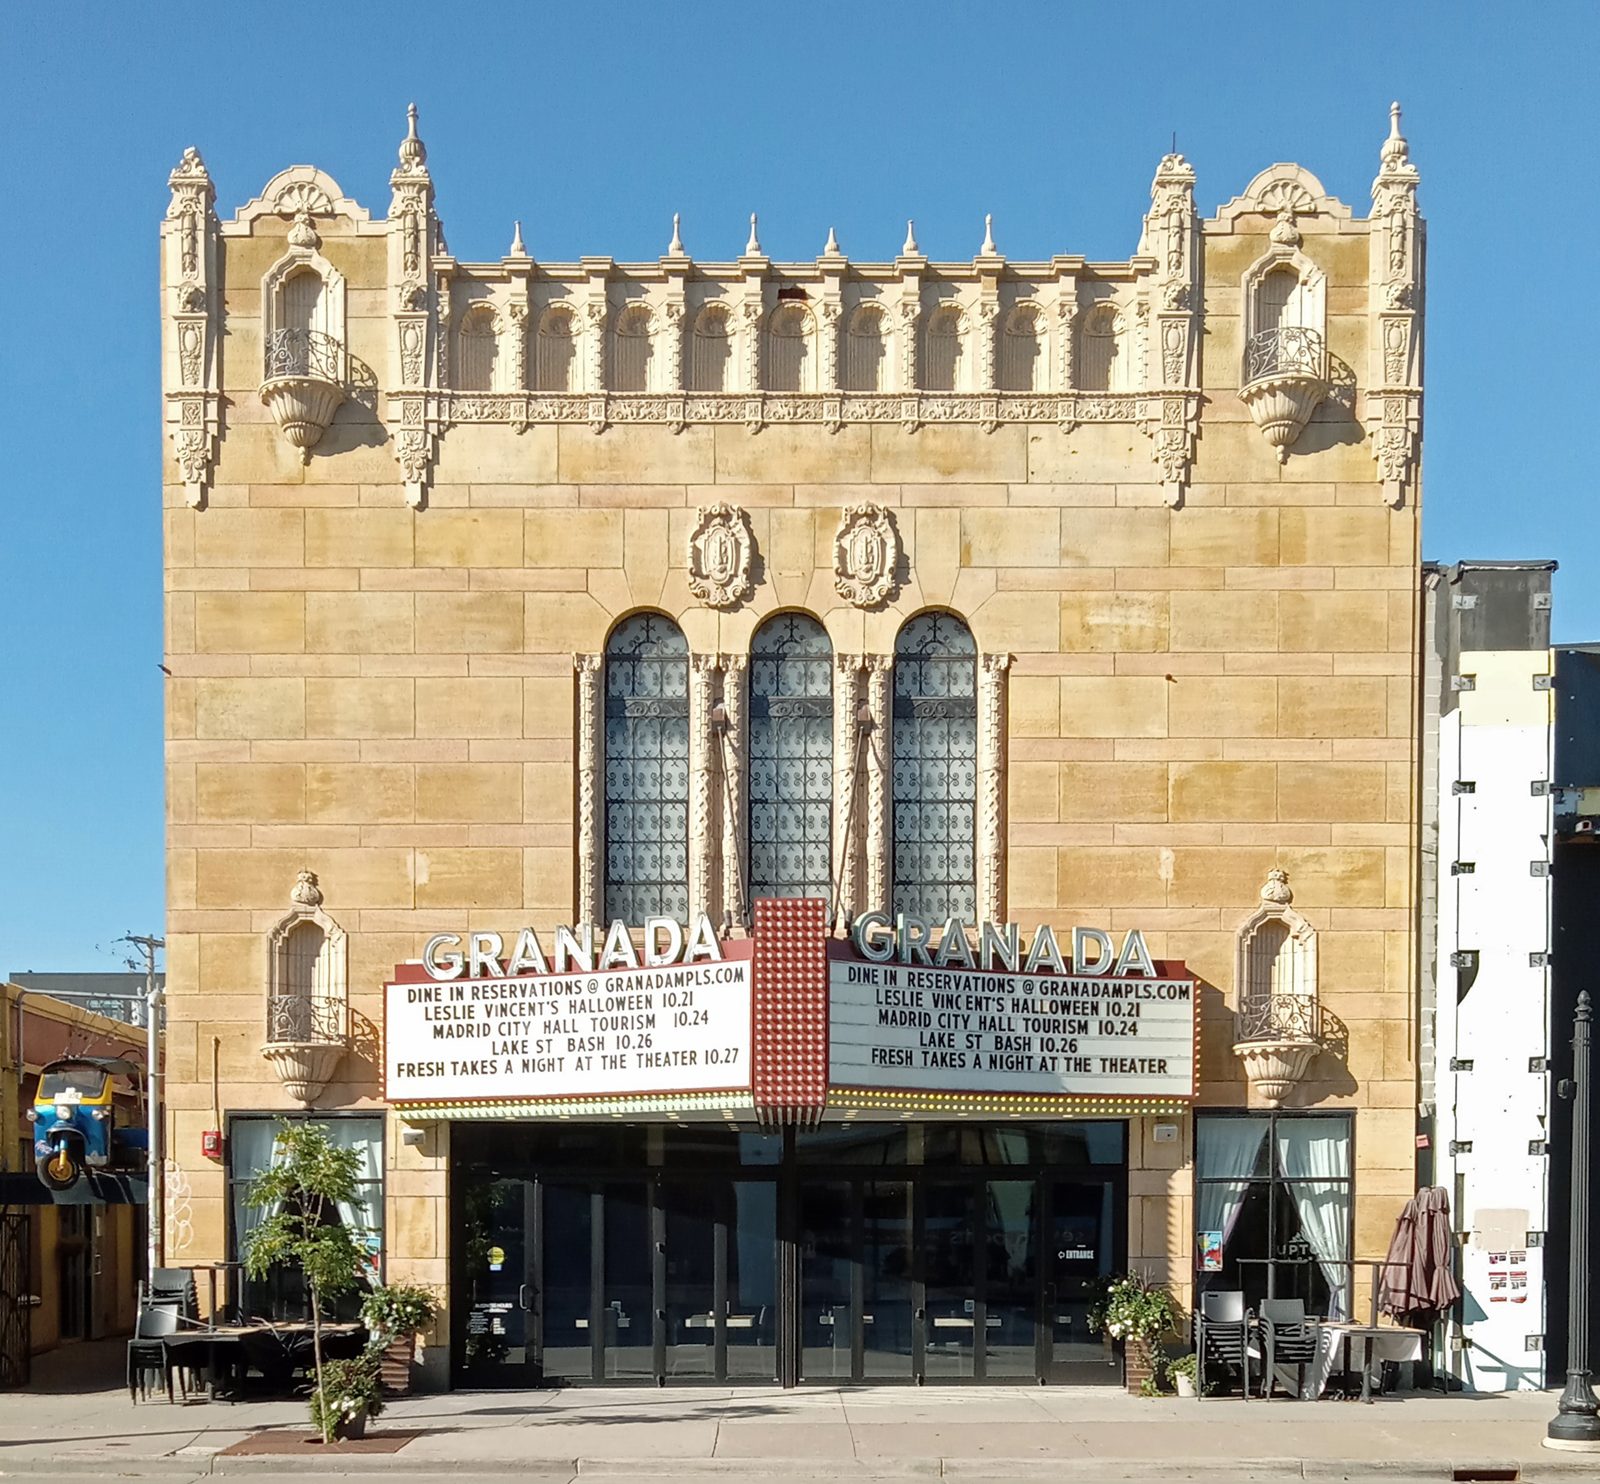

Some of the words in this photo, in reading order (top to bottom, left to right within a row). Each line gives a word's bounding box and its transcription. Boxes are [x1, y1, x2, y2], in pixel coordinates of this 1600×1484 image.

[422, 912, 723, 981] GRANADA
[852, 911, 1158, 978] GRANADA
[408, 987, 442, 1003] DINE
[450, 986, 464, 1001] IN
[471, 980, 582, 1000] RESERVATIONS
[587, 978, 599, 994] @
[605, 967, 744, 993] GRANADAMPLS.COM
[848, 966, 879, 985] DINE
[884, 969, 897, 986] IN
[908, 972, 1015, 994] RESERVATIONS
[1022, 979, 1034, 995] @
[1039, 980, 1190, 1000] GRANADAMPLS.COM
[425, 1004, 475, 1021] LESLIE
[485, 1000, 559, 1018] VINCENT'S
[569, 994, 653, 1014] HALLOWEEN
[663, 991, 693, 1008] 10.21
[876, 989, 923, 1007] LESLIE
[932, 992, 1005, 1013] VINCENT'S
[1011, 998, 1099, 1017] HALLOWEEN
[1106, 1002, 1140, 1018] 10.21
[433, 1023, 491, 1039] MADRID
[498, 1021, 531, 1036] CITY
[543, 1018, 579, 1034] HALL
[590, 1014, 656, 1032] TOURISM
[674, 1010, 709, 1028] 10.24
[878, 1009, 932, 1028] MADRID
[937, 1013, 970, 1030] CITY
[979, 1015, 1015, 1032] HALL
[1023, 1017, 1088, 1035] TOURISM
[1098, 1021, 1138, 1036] 10.24
[492, 1040, 529, 1055] LAKE
[536, 1039, 553, 1054] ST
[568, 1036, 605, 1052] BASH
[616, 1033, 653, 1050] 10.26
[920, 1031, 955, 1048] LAKE
[965, 1034, 982, 1050] ST
[994, 1035, 1031, 1052] BASH
[1040, 1038, 1078, 1053] 10.26
[397, 1062, 445, 1078] FRESH
[451, 1060, 498, 1076] TAKES
[505, 1059, 513, 1074] A
[522, 1057, 565, 1073] NIGHT
[575, 1056, 593, 1071] AT
[601, 1054, 627, 1070] THE
[636, 1051, 697, 1068] THEATER
[705, 1048, 739, 1065] 10.27
[872, 1048, 913, 1066] FRESH
[922, 1051, 966, 1068] TAKES
[973, 1053, 982, 1069] A
[989, 1054, 1033, 1071] NIGHT
[1039, 1056, 1058, 1072] AT
[1064, 1057, 1092, 1073] THE
[1100, 1058, 1167, 1074] THEATER
